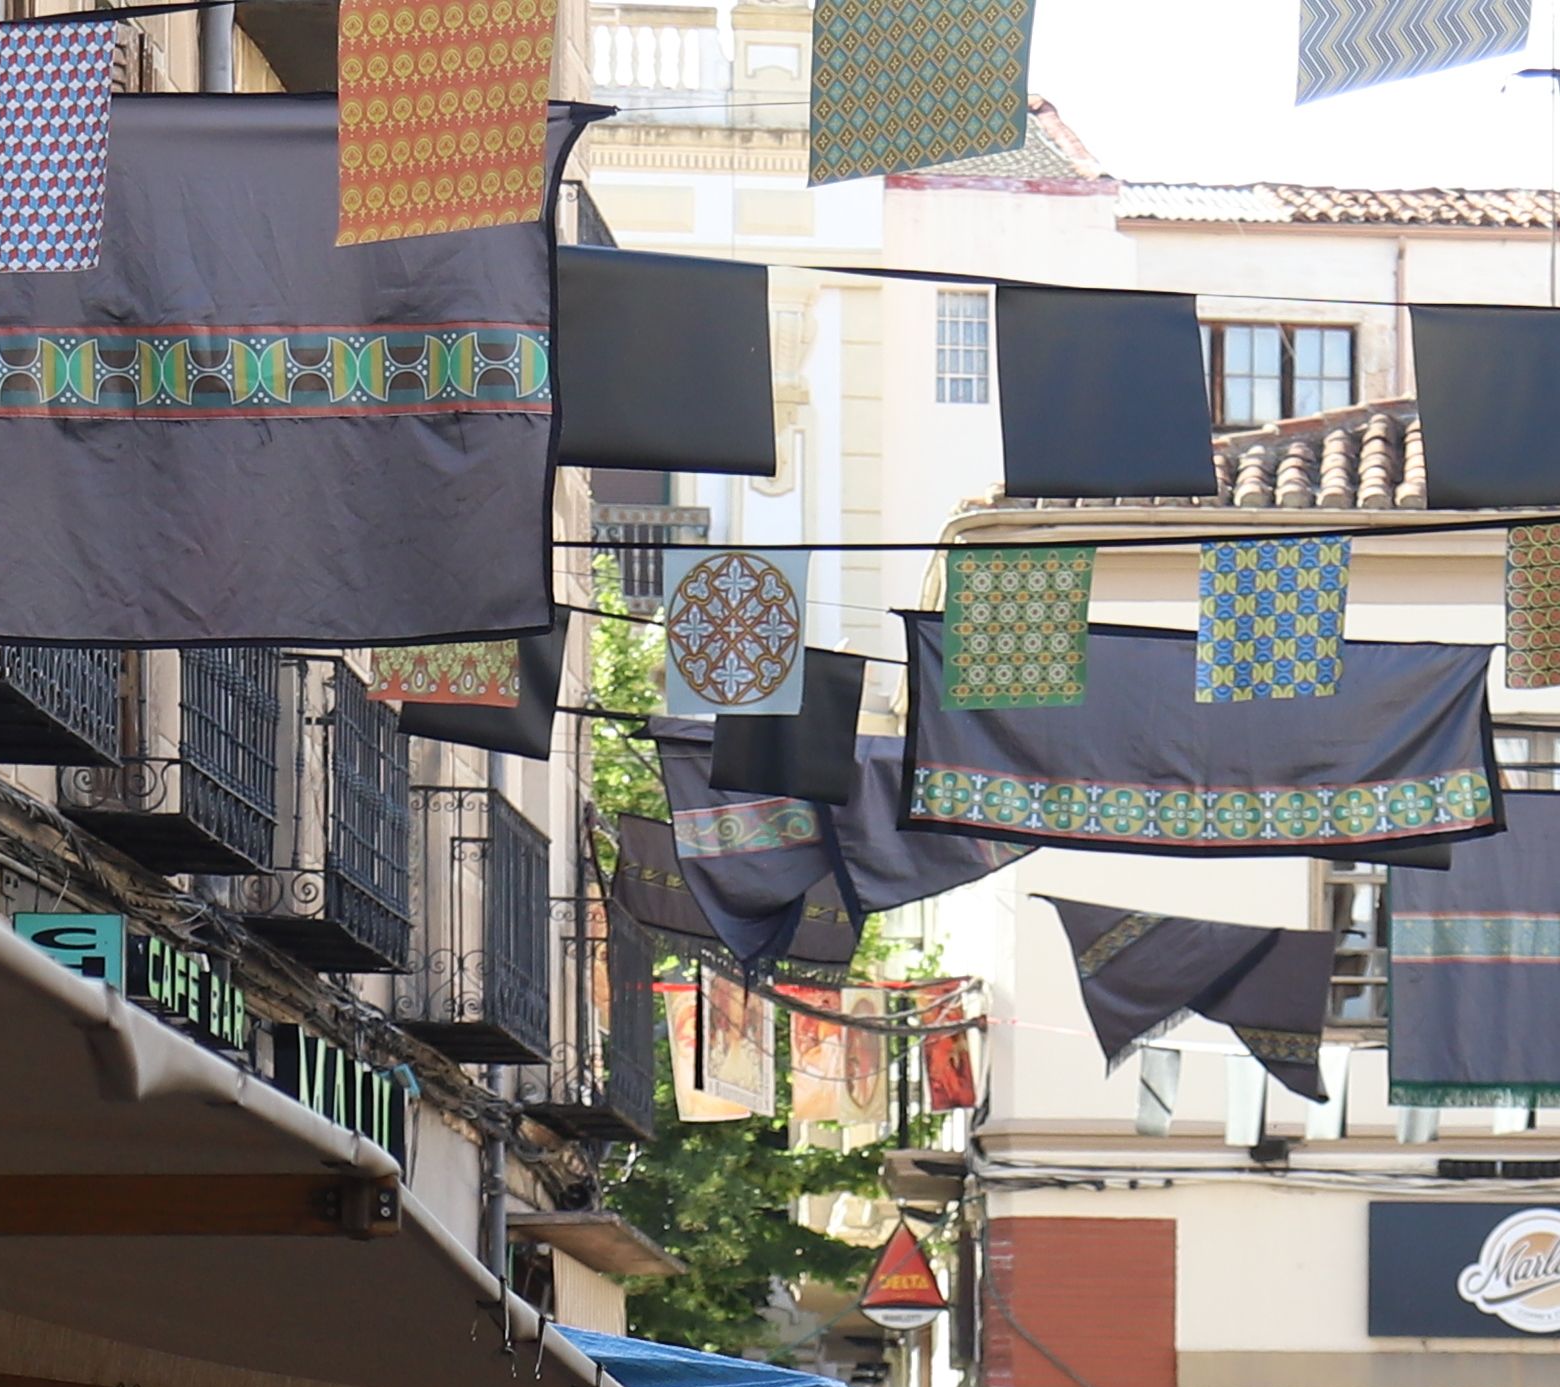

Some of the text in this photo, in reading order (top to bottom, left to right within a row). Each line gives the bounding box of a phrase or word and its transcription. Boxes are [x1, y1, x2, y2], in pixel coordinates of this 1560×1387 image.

[148, 936, 244, 1051] CAFE BAR
[878, 1274, 930, 1290] DELTA
